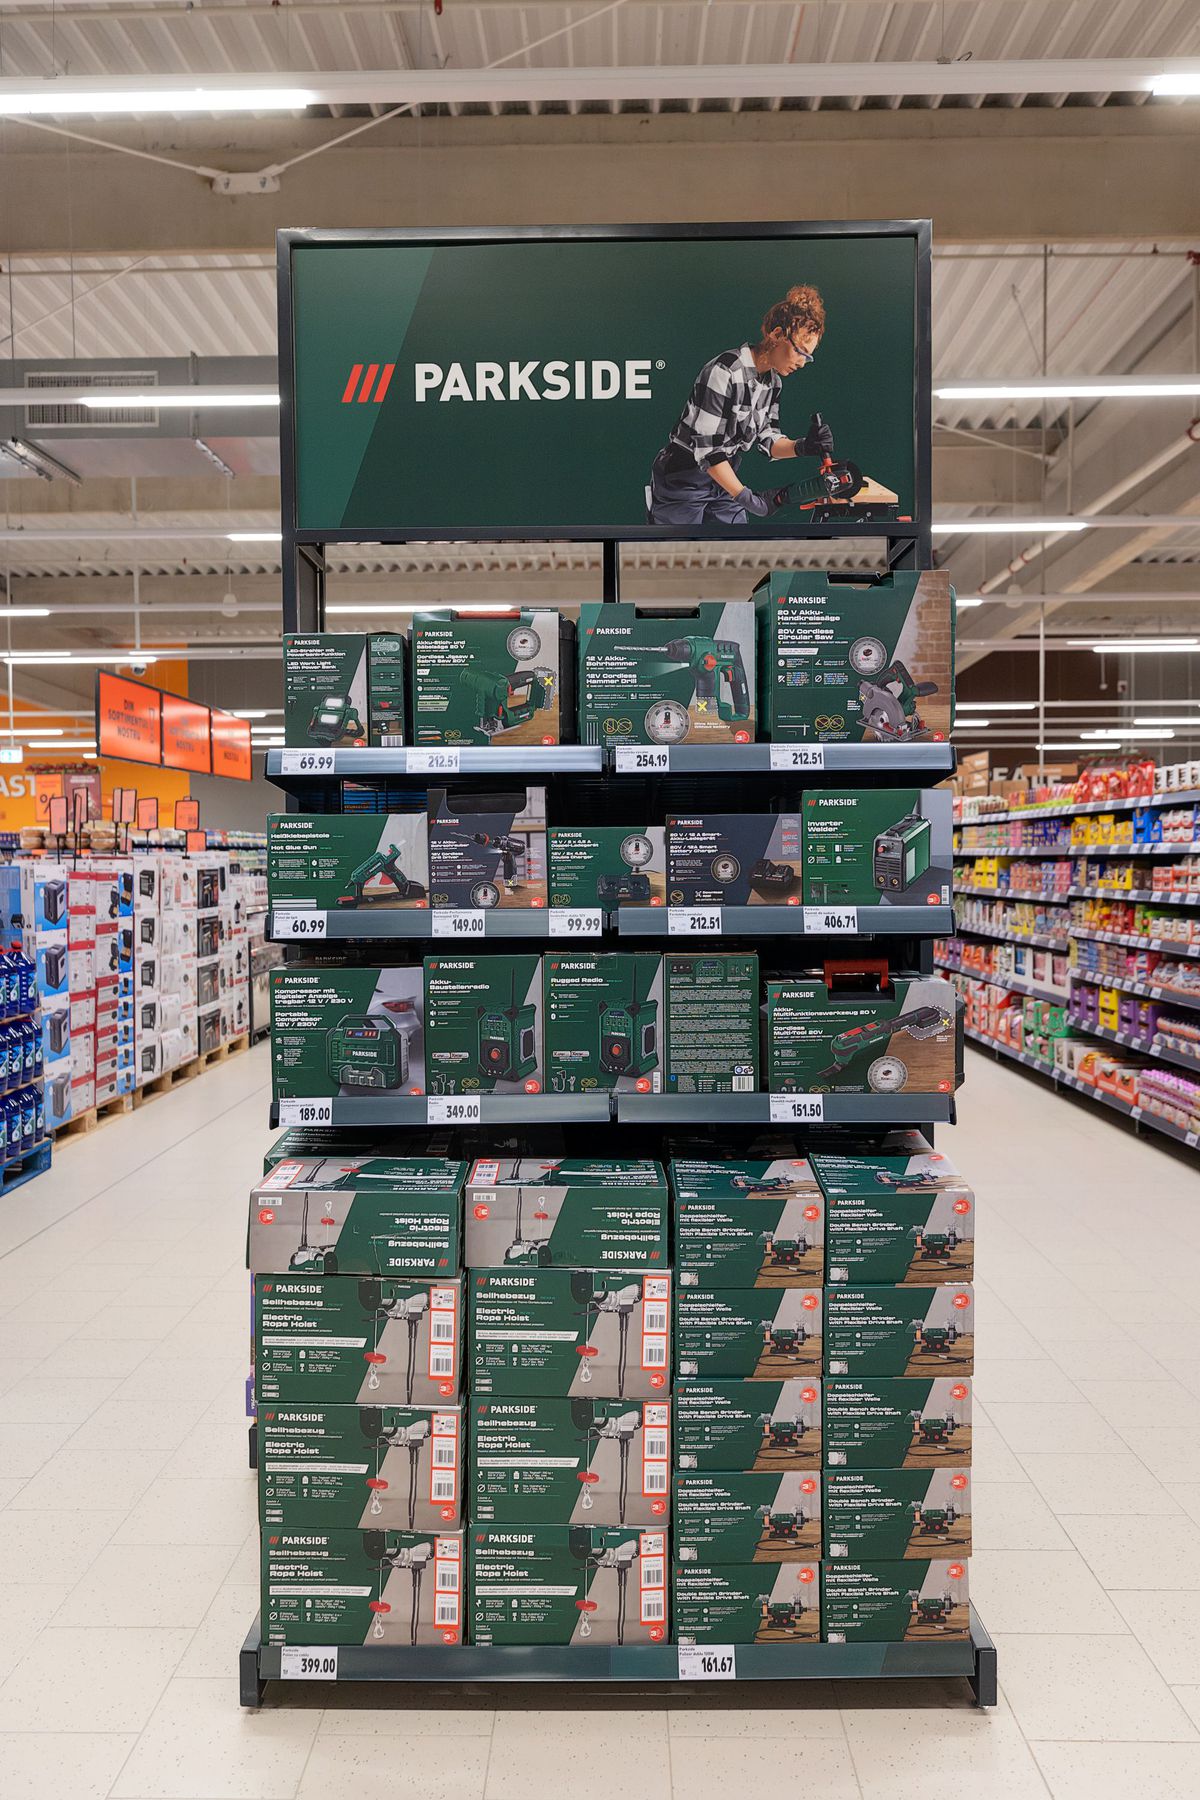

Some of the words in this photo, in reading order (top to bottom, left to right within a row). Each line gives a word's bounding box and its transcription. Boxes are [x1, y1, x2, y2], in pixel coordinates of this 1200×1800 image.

[300, 757, 333, 770] 69.99
[428, 755, 458, 768] 212.51
[636, 754, 667, 767] 254.19
[792, 753, 823, 765] 212.51
[292, 920, 324, 933] 60.99
[452, 919, 483, 931] 149.00
[568, 918, 600, 931] 99.99
[690, 917, 720, 930] 212.51
[824, 916, 856, 928] 406.71
[300, 1108, 330, 1121] 189.00
[446, 1105, 478, 1119] 349.00
[791, 1103, 821, 1117] 151.50
[601, 1233, 660, 1241] Seilhebezug
[602, 1251, 646, 1259] PARKSIDE
[389, 1258, 435, 1267] PARKSIDE
[490, 1277, 535, 1286] PARKSIDE
[276, 1285, 321, 1294] PARKSIDE
[476, 1292, 536, 1300] Seilhebezug
[262, 1299, 323, 1307] Seilhebezug
[491, 1405, 535, 1414] PARKSIDE
[278, 1413, 323, 1422] PARKSIDE
[265, 1426, 325, 1435] Seilhebezug
[282, 1536, 327, 1545] PARKSIDE
[489, 1534, 533, 1543] PARKSIDE
[475, 1548, 535, 1556] Seilhebezug
[301, 1658, 335, 1673] 399.00
[702, 1657, 733, 1673] 161.67
